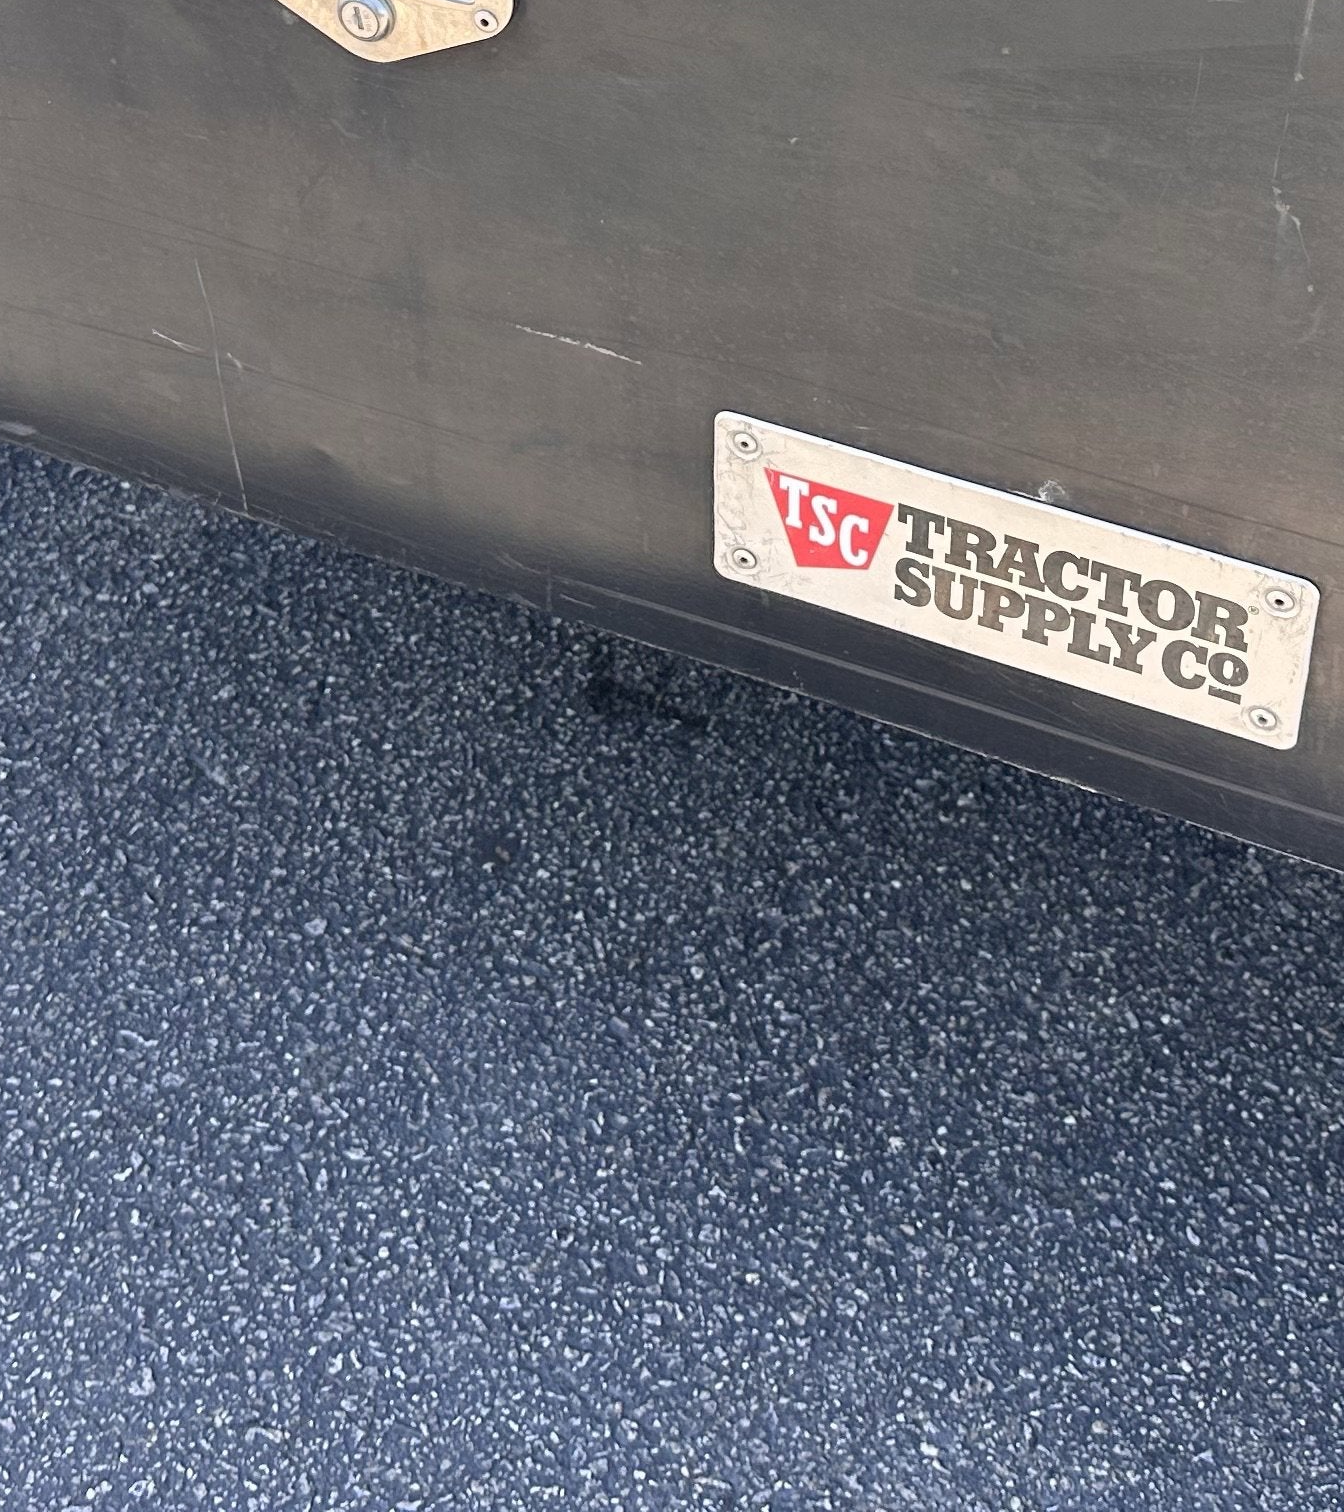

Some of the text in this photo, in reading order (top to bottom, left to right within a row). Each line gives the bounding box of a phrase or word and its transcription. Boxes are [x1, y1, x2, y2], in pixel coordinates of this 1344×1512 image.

[779, 474, 869, 567] TSC
[897, 502, 1249, 653] TRACTOR
[894, 558, 1157, 675] SUPPLY
